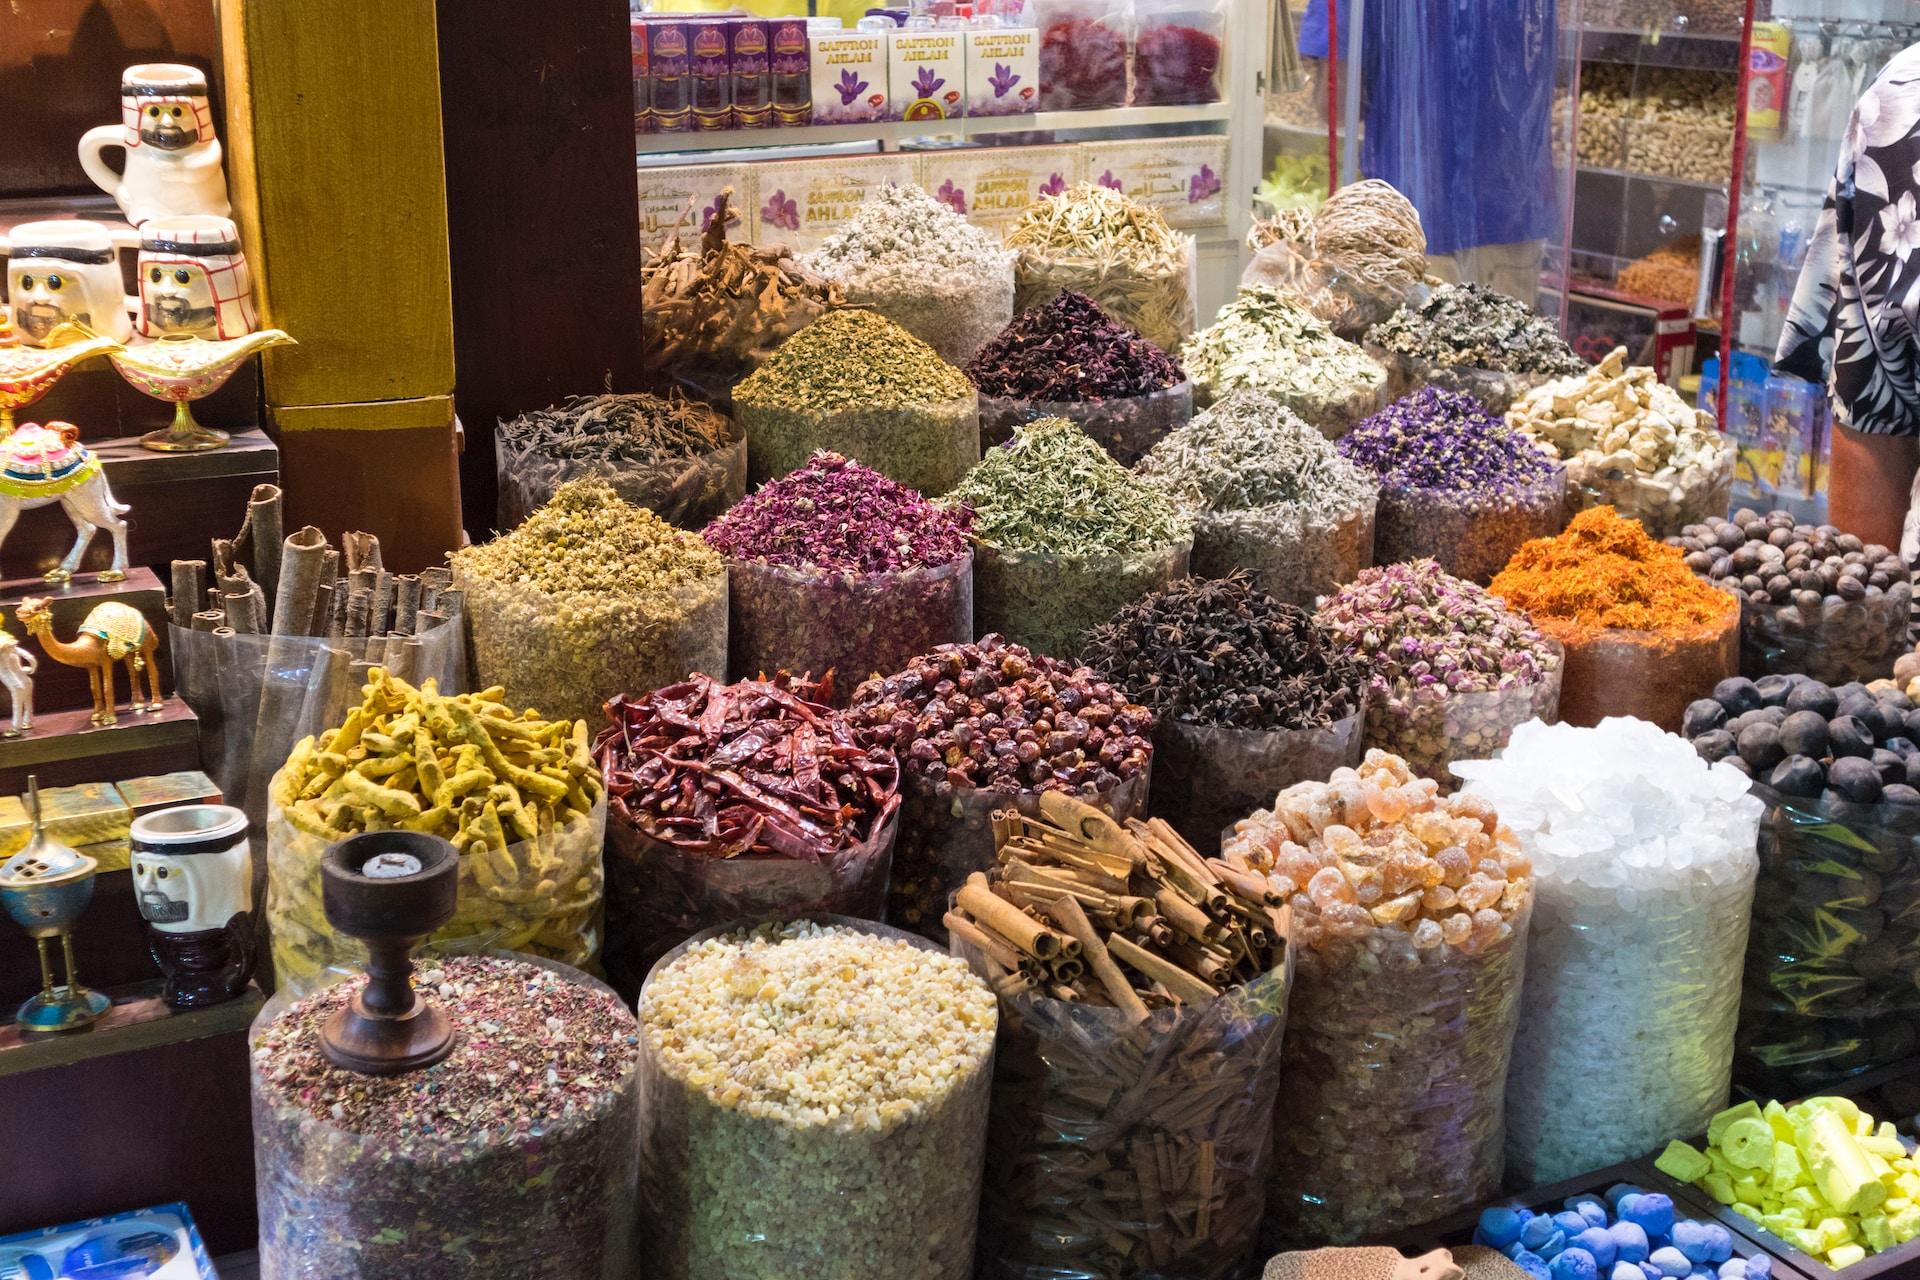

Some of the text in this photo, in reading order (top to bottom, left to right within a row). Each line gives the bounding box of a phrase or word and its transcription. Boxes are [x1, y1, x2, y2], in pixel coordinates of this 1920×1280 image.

[819, 40, 878, 52] SAFFRON
[896, 37, 954, 49] SAFFRON
[974, 34, 1030, 46] SAFFRON
[826, 52, 872, 64] AHLAM
[904, 49, 949, 61] AHLAM
[981, 46, 1025, 58] AHLAM
[975, 178, 1028, 194] SAFFRON
[807, 189, 865, 205] SAFFRON
[972, 191, 1030, 210] AHLAM
